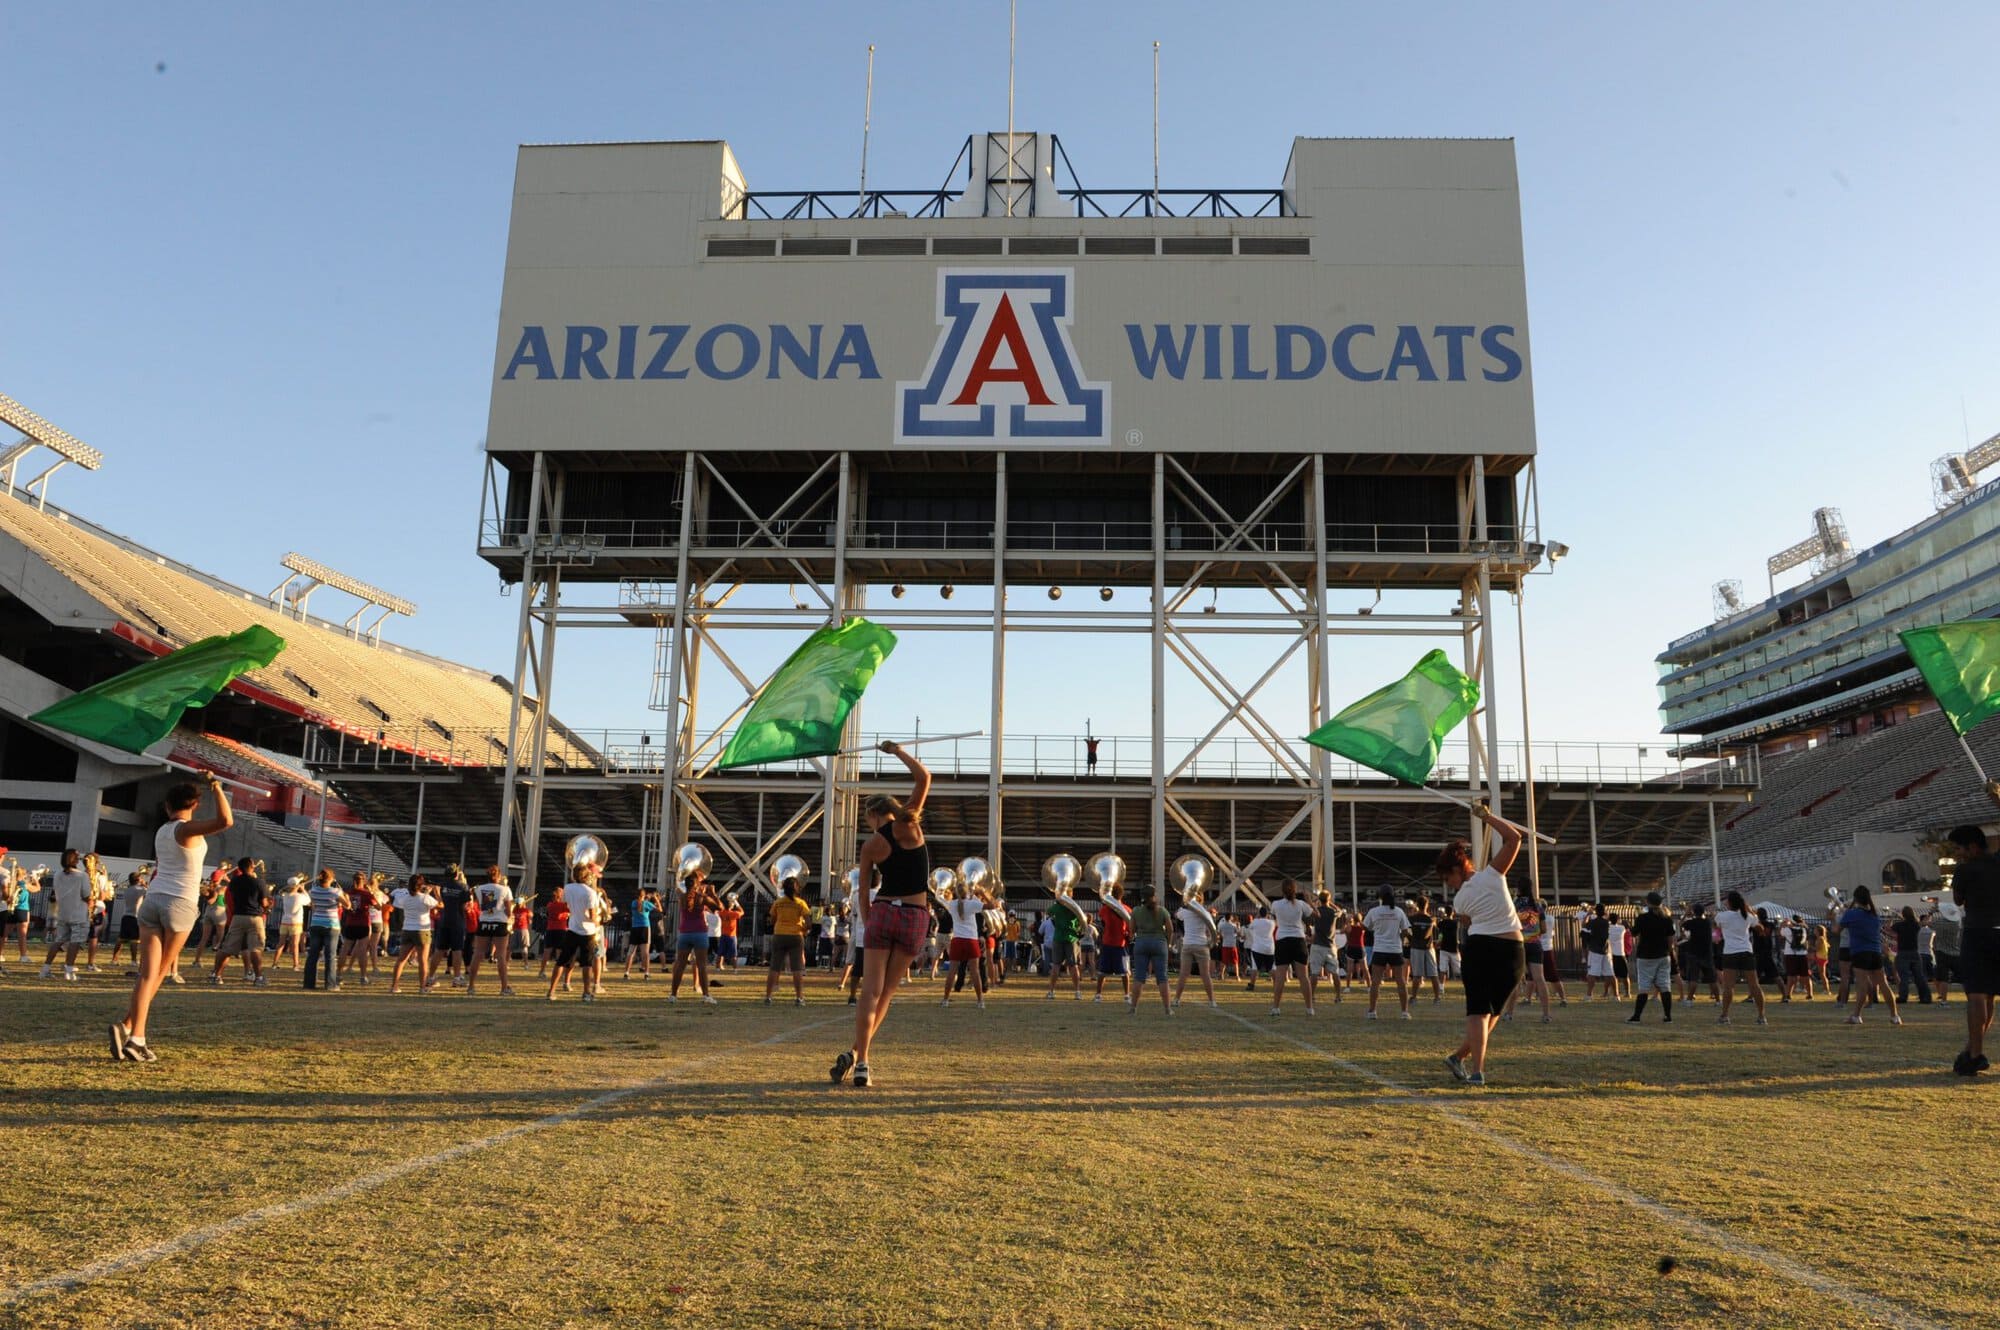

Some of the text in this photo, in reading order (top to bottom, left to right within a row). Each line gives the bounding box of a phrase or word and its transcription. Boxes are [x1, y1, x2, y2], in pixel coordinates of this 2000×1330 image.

[501, 267, 1523, 446] ARIZONA A WILDCATS
